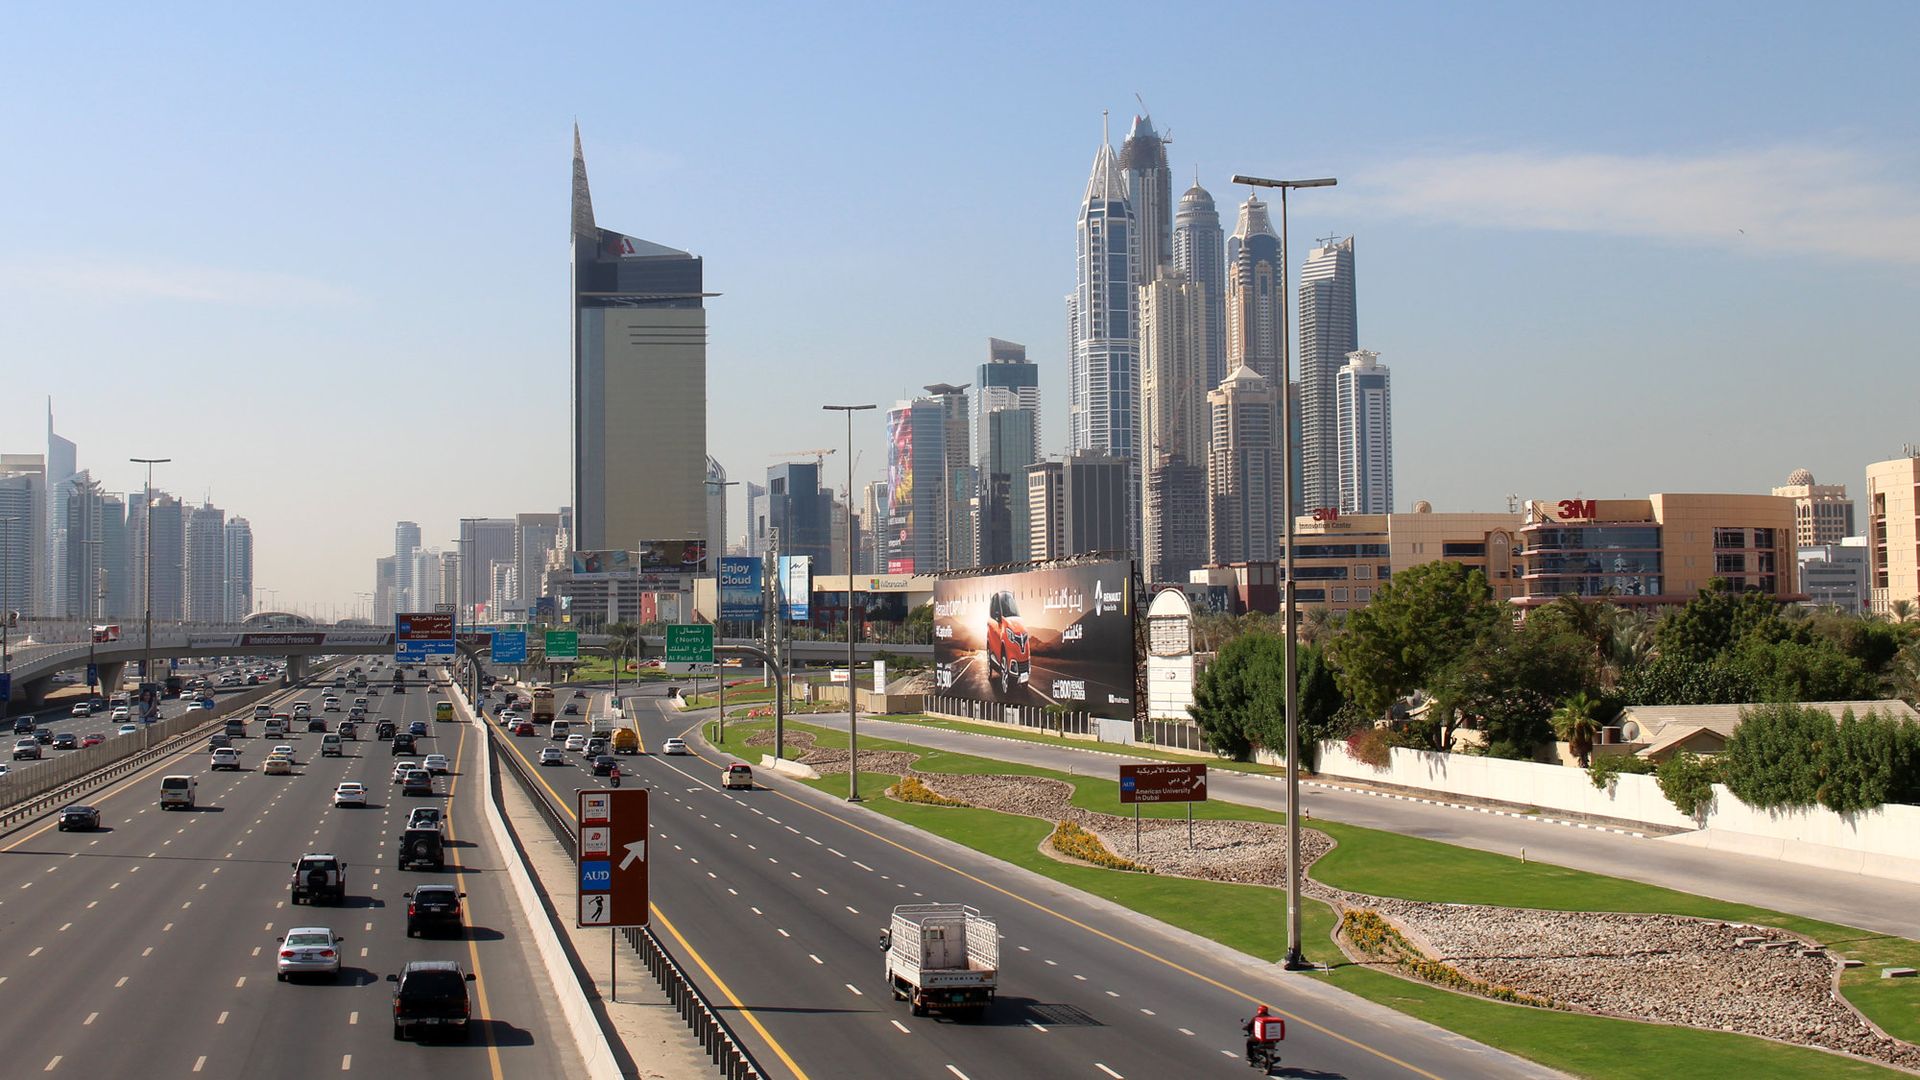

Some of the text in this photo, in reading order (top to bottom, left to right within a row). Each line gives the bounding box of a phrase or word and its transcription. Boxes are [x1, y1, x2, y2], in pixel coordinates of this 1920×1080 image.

[1313, 507, 1338, 521] 3M
[1558, 499, 1597, 519] 3M
[721, 563, 750, 574] Enjoy
[721, 576, 752, 585] Cloud
[880, 580, 908, 588] Microsoft
[1103, 592, 1122, 602] RENAULT
[248, 636, 286, 644] International
[287, 636, 315, 644] Presence
[1060, 679, 1071, 699] 800
[1167, 776, 1191, 786] في دبي
[1162, 787, 1191, 796] University
[583, 870, 610, 881] AUD
